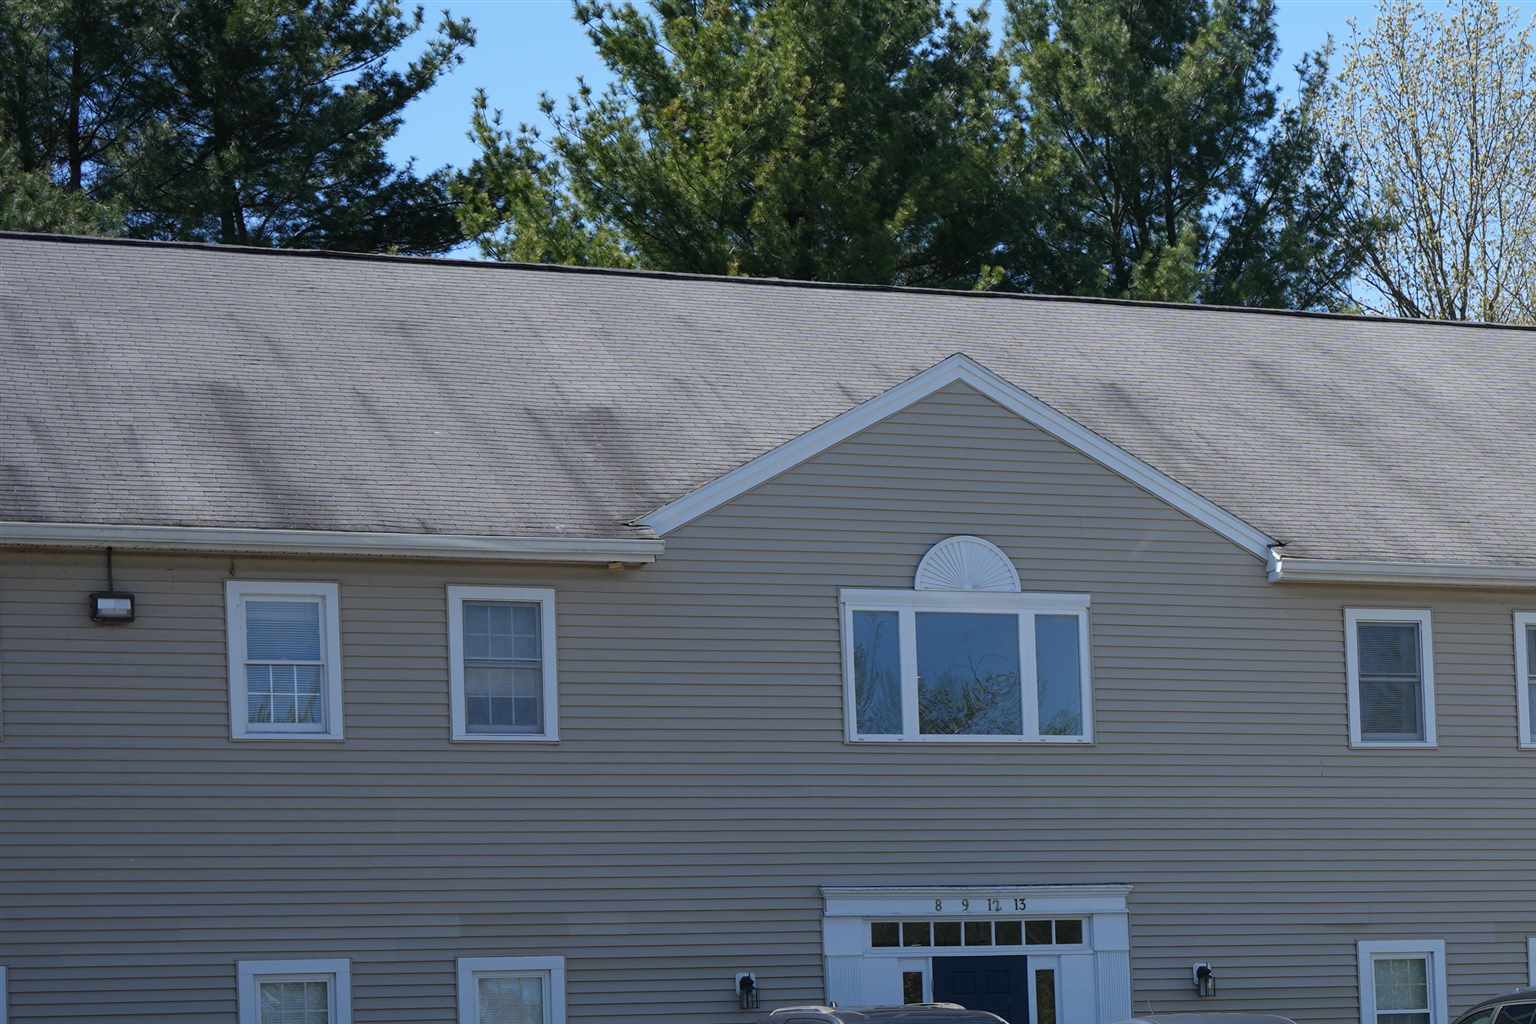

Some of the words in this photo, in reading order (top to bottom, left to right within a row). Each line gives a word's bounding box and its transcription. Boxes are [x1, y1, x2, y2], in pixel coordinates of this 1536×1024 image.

[935, 898, 943, 912] 8
[962, 898, 969, 912] 9
[987, 898, 1002, 912] 12
[1014, 898, 1026, 911] 13
